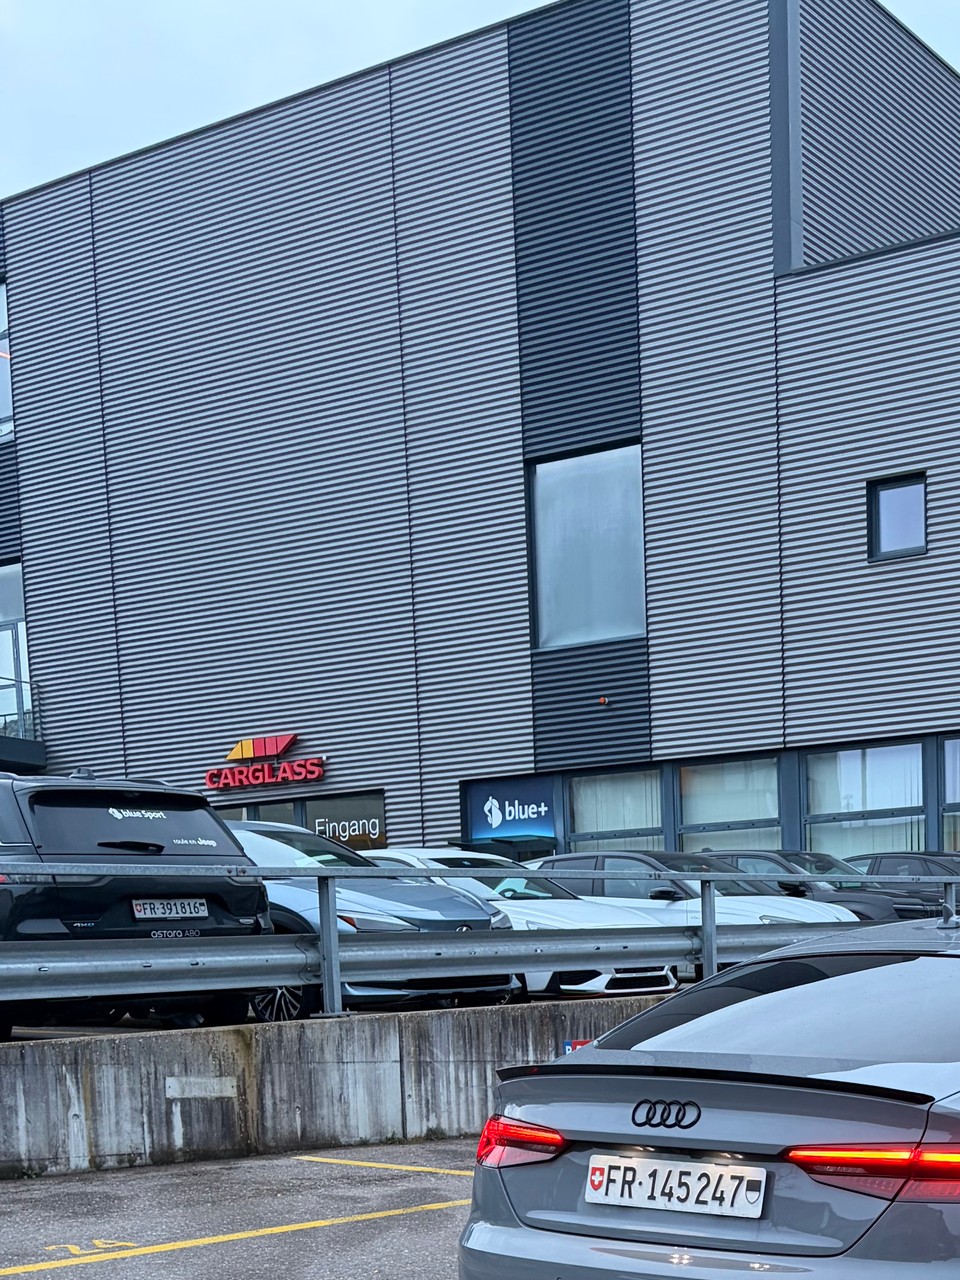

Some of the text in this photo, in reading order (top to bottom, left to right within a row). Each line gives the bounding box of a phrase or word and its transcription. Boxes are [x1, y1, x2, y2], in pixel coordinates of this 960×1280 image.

[205, 758, 325, 789] CARGLASS
[120, 809, 167, 820] blue Sport
[505, 799, 548, 821] blue+
[315, 818, 380, 841] Eingang
[197, 837, 217, 848] Jeep
[150, 929, 200, 938] astara ABO
